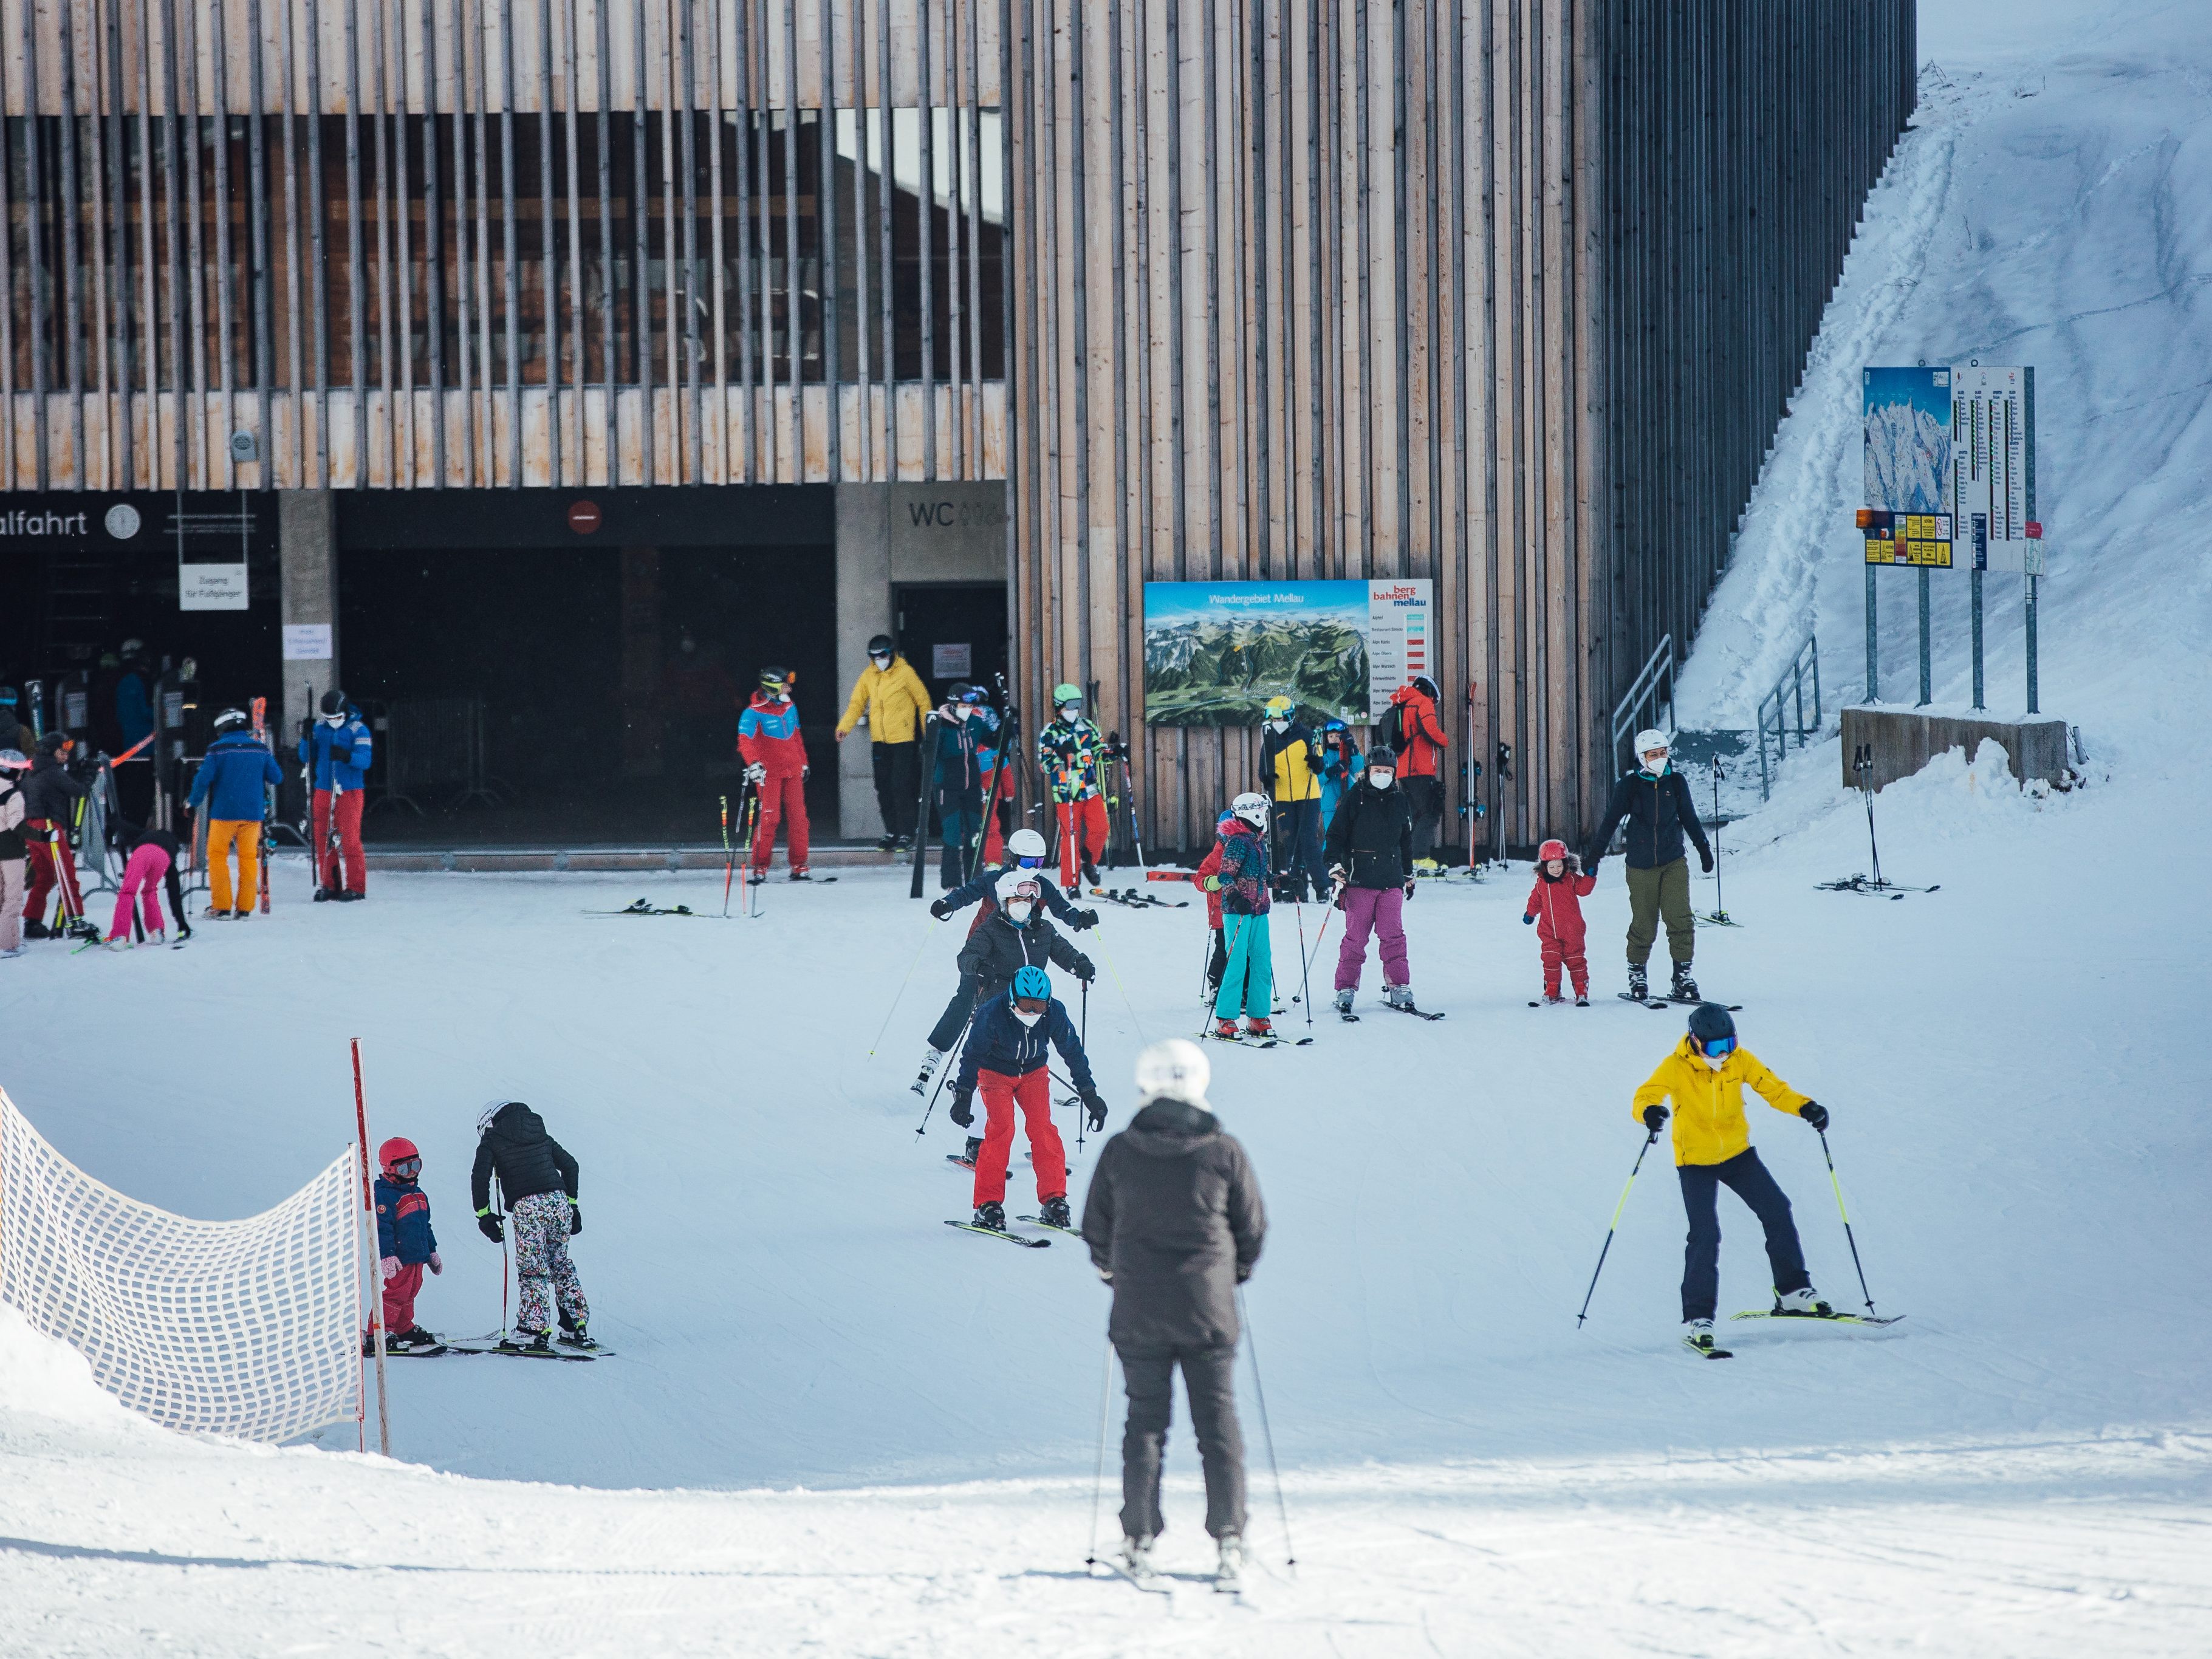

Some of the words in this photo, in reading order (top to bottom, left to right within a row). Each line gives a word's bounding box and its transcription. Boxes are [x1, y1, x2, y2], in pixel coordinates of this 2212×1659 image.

[908, 502, 954, 527] WC
[1394, 585, 1416, 595] berg
[1209, 593, 1271, 606] Wandergebiet
[1274, 593, 1304, 603] Mellau
[1374, 592, 1410, 600] bahnen
[1394, 598, 1426, 606] mellau
